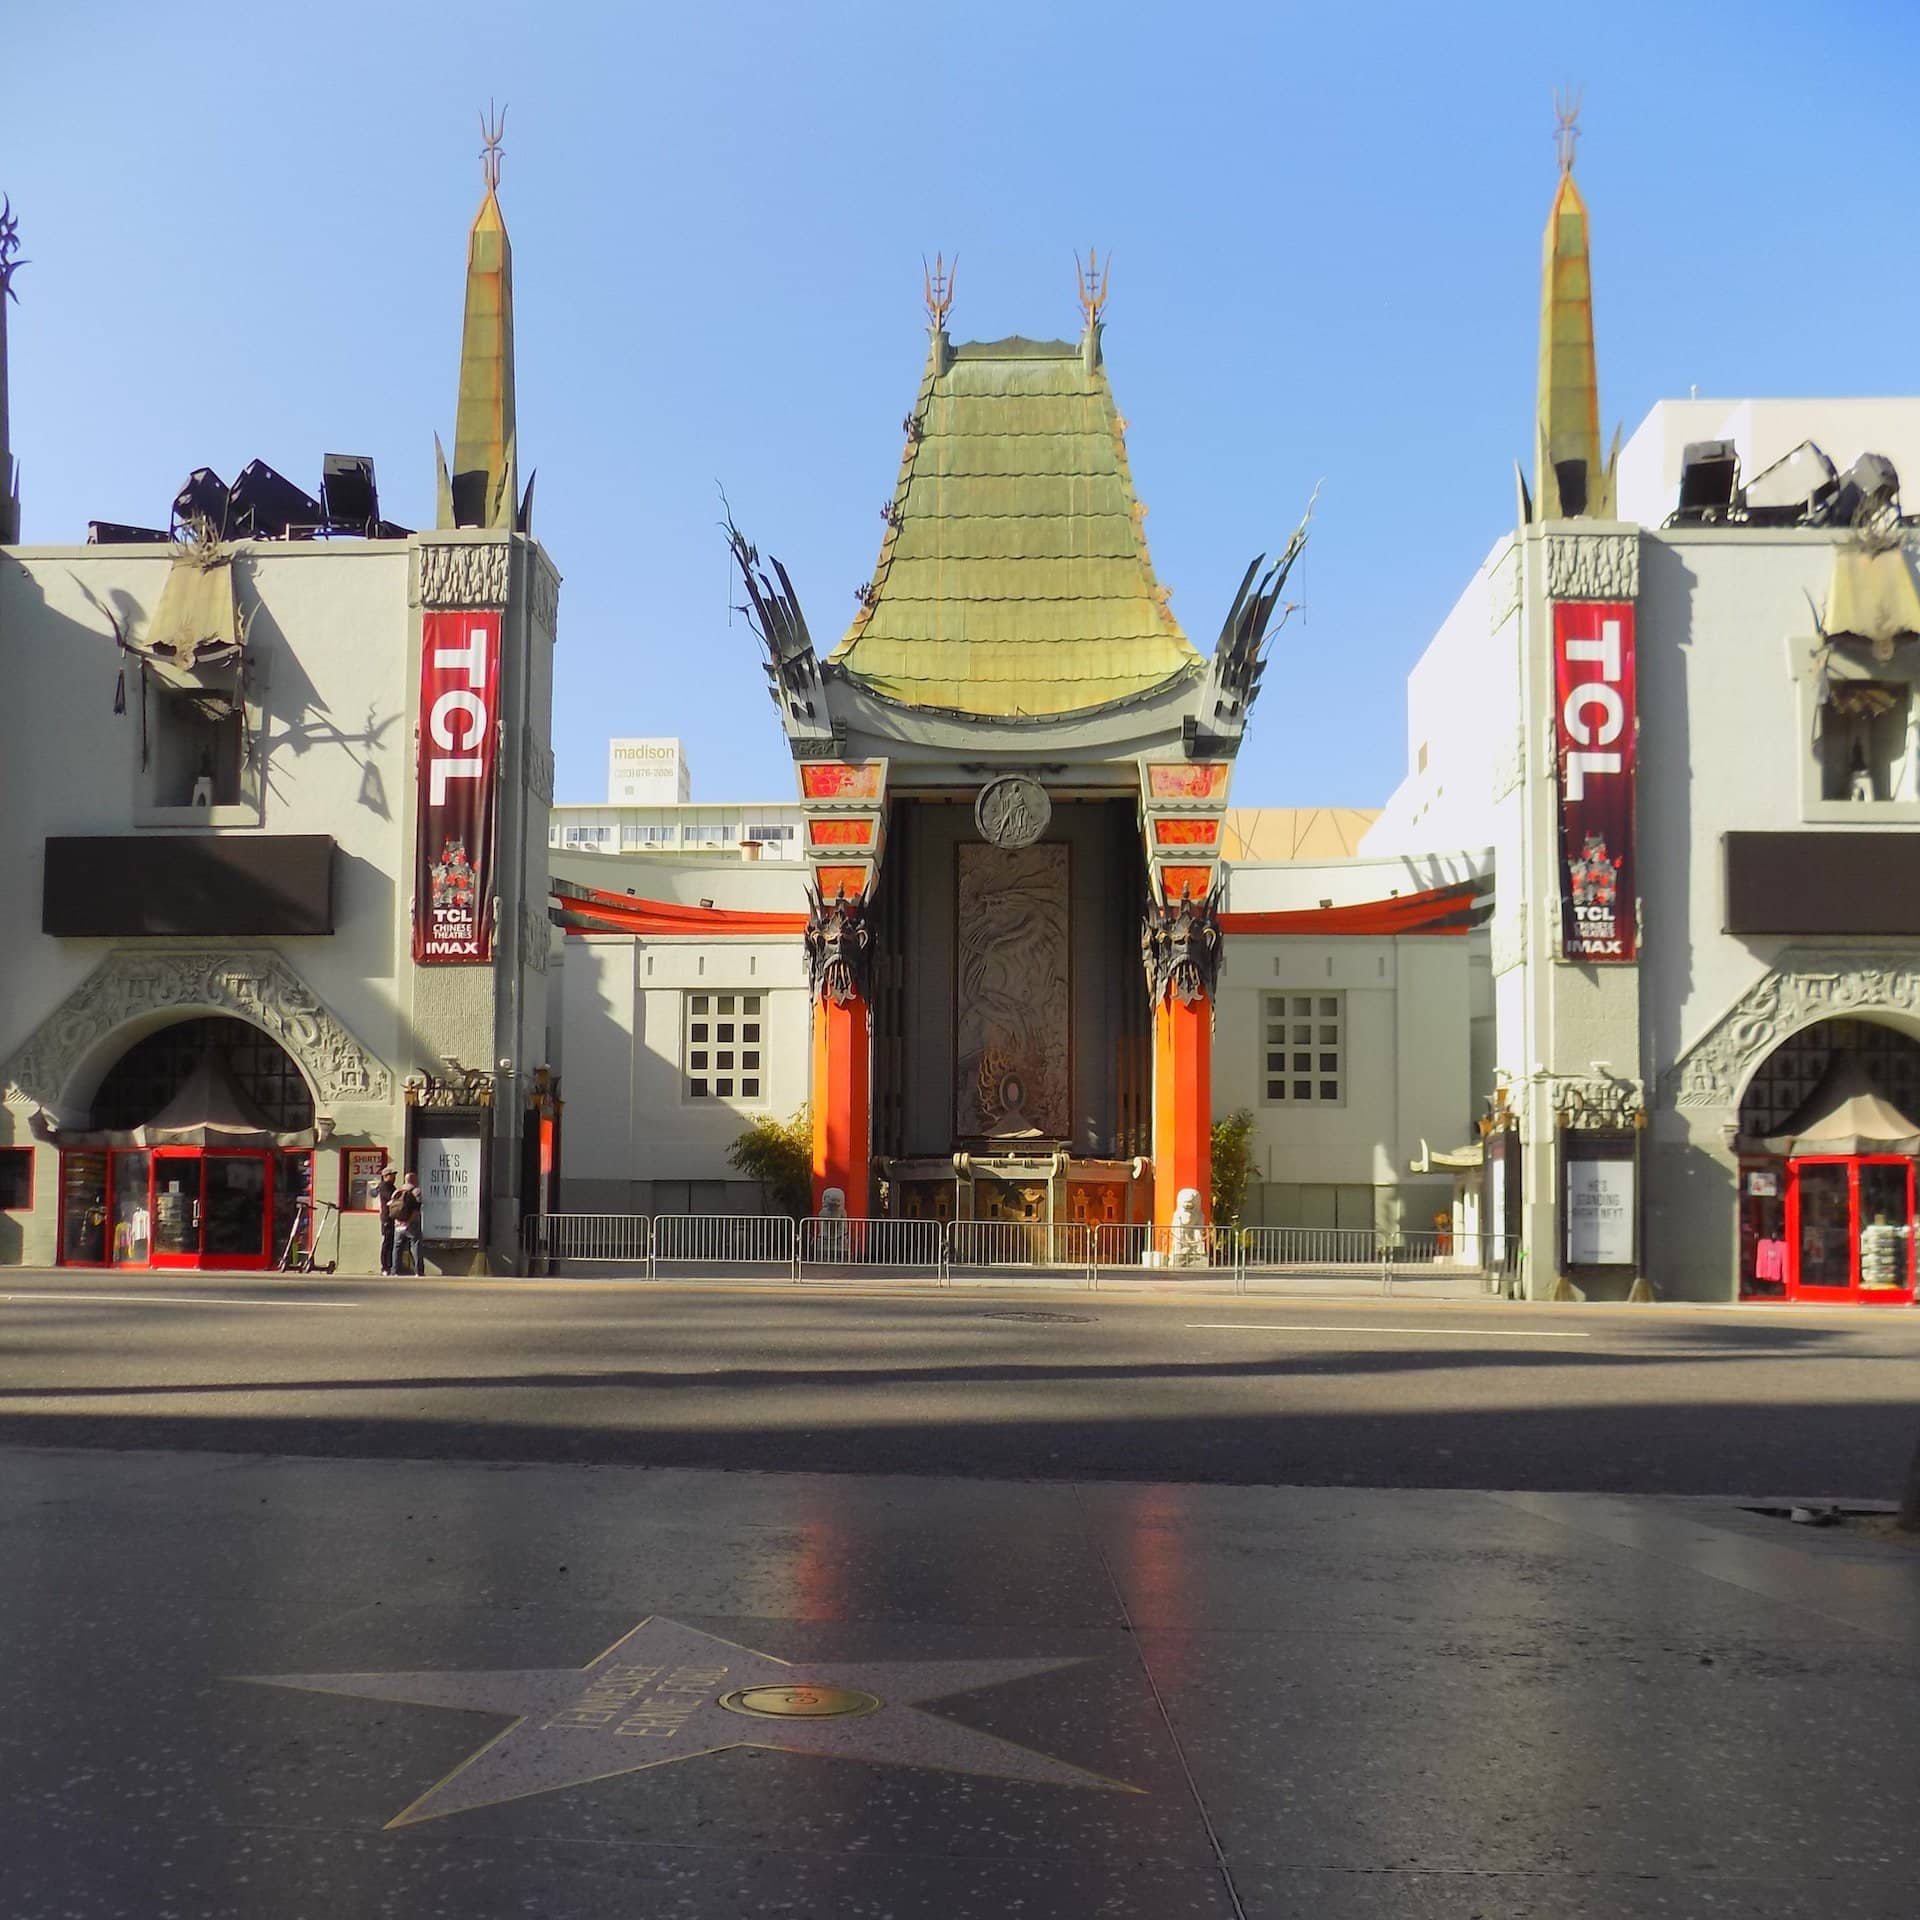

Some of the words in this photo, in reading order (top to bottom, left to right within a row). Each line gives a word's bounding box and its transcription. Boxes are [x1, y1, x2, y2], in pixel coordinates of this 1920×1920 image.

[430, 629, 487, 806] TCL
[1564, 620, 1624, 801] TCL
[614, 744, 674, 759] madison
[433, 909, 473, 923] TCL
[1574, 906, 1616, 921] TCL
[425, 942, 479, 954] IMAX
[1567, 940, 1622, 954] IMAX
[439, 1153, 460, 1168] HE'S
[431, 1169, 468, 1183] SITTING
[430, 1185, 440, 1198] IN
[442, 1185, 468, 1199] YOUR
